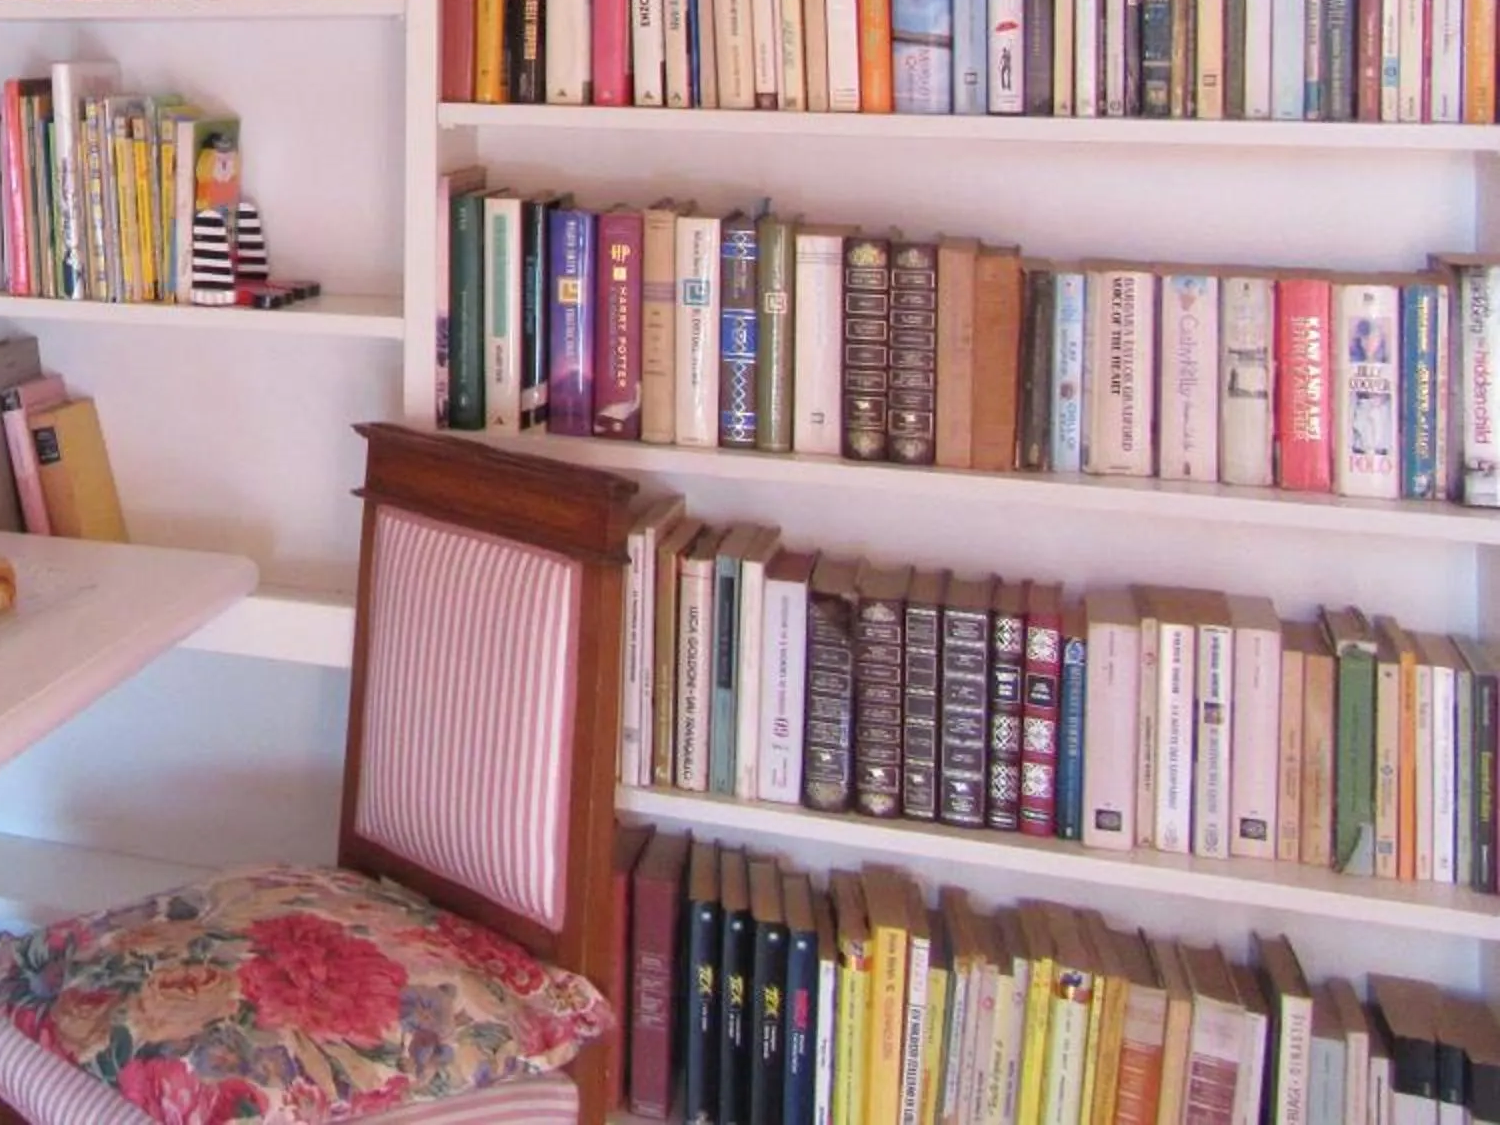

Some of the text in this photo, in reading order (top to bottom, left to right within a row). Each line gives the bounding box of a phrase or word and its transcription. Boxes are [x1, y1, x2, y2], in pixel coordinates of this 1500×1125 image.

[617, 285, 628, 388] HARRY POTTER
[1110, 278, 1122, 396] VOICE OF THE HEART
[1177, 314, 1198, 397] Cathy Kelly
[1122, 278, 1135, 452] BARBARA TAYLOR BRADFORD
[1307, 365, 1322, 400] AND
[1474, 351, 1490, 406] hidden
[1474, 406, 1491, 444] child
[1349, 456, 1393, 474] POLO
[689, 605, 699, 632] LUCA
[688, 637, 699, 688] GOLDONI
[1289, 1012, 1305, 1076] DINASTIE
